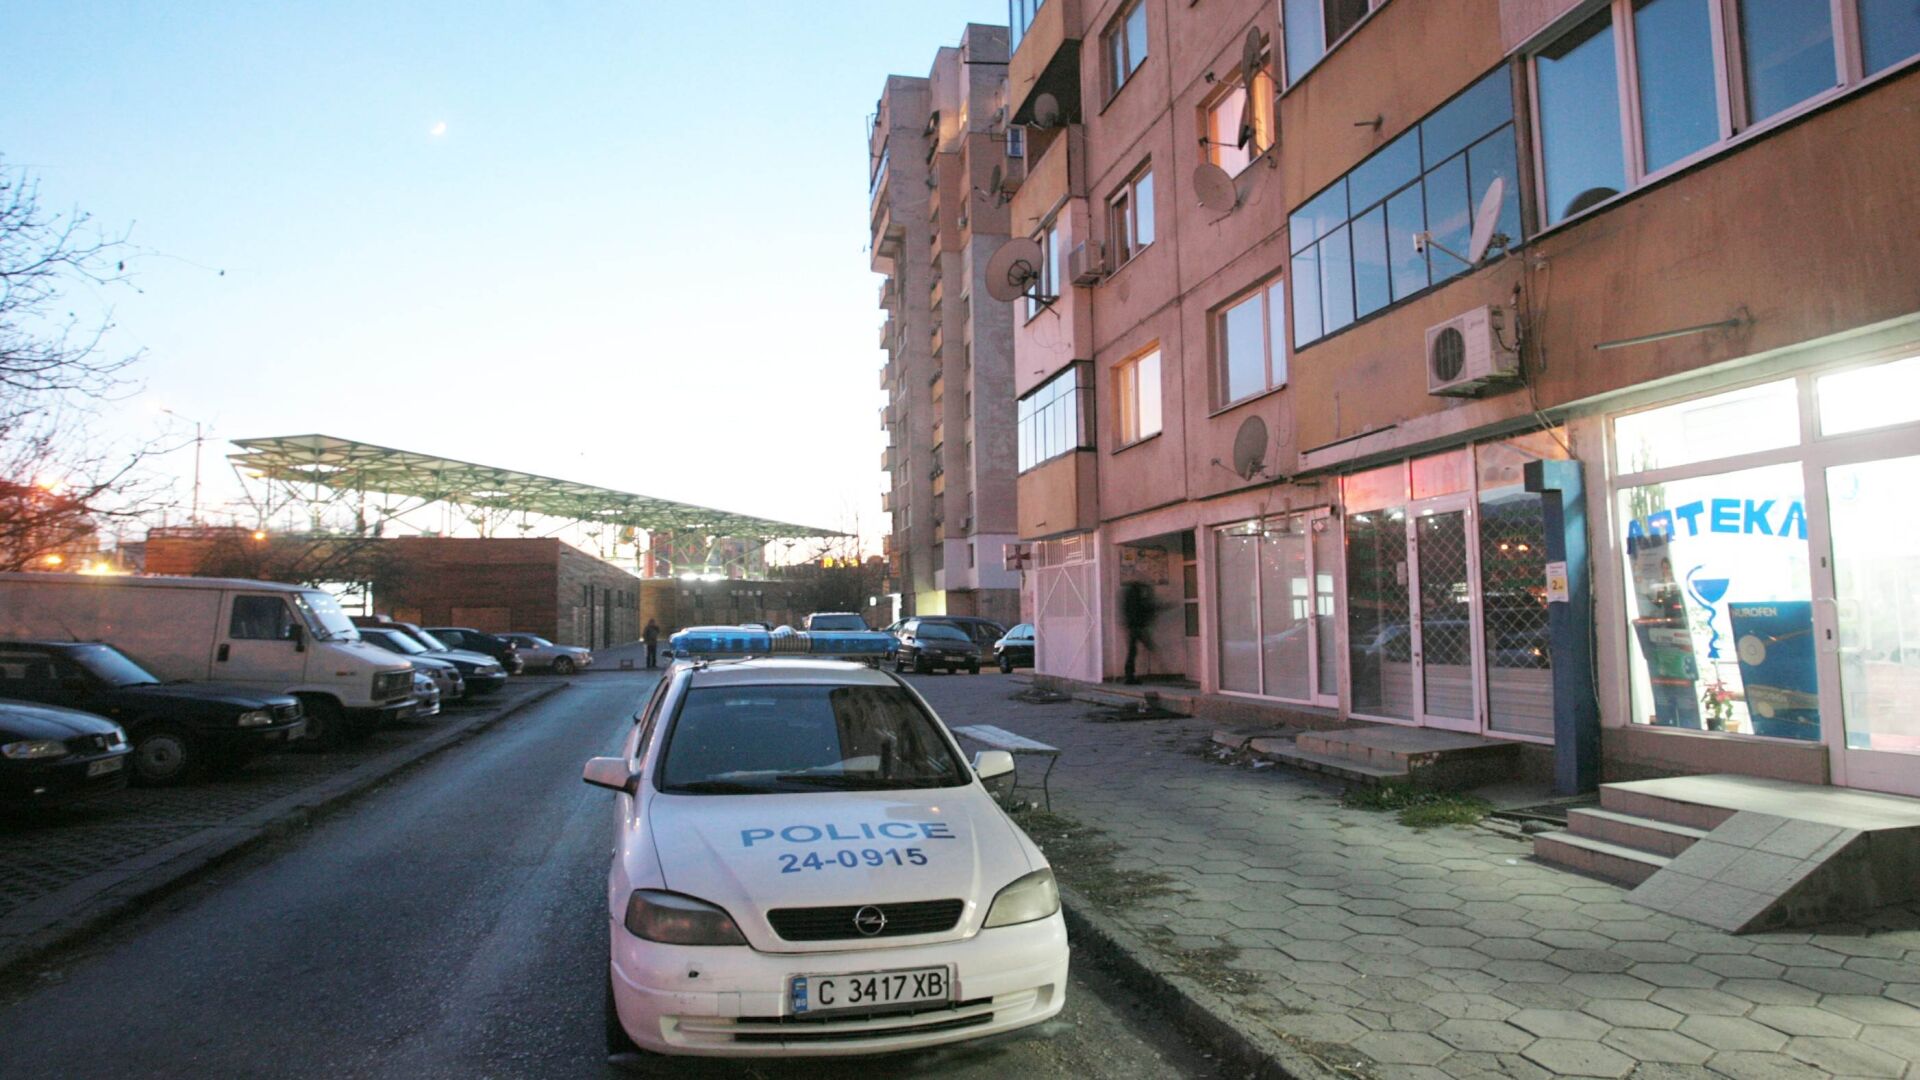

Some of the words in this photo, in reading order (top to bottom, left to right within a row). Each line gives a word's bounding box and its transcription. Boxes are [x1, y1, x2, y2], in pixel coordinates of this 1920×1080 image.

[740, 822, 956, 847] POLICE
[778, 848, 928, 873] 24-0915
[819, 980, 835, 1005] C
[848, 975, 907, 1003] 3417
